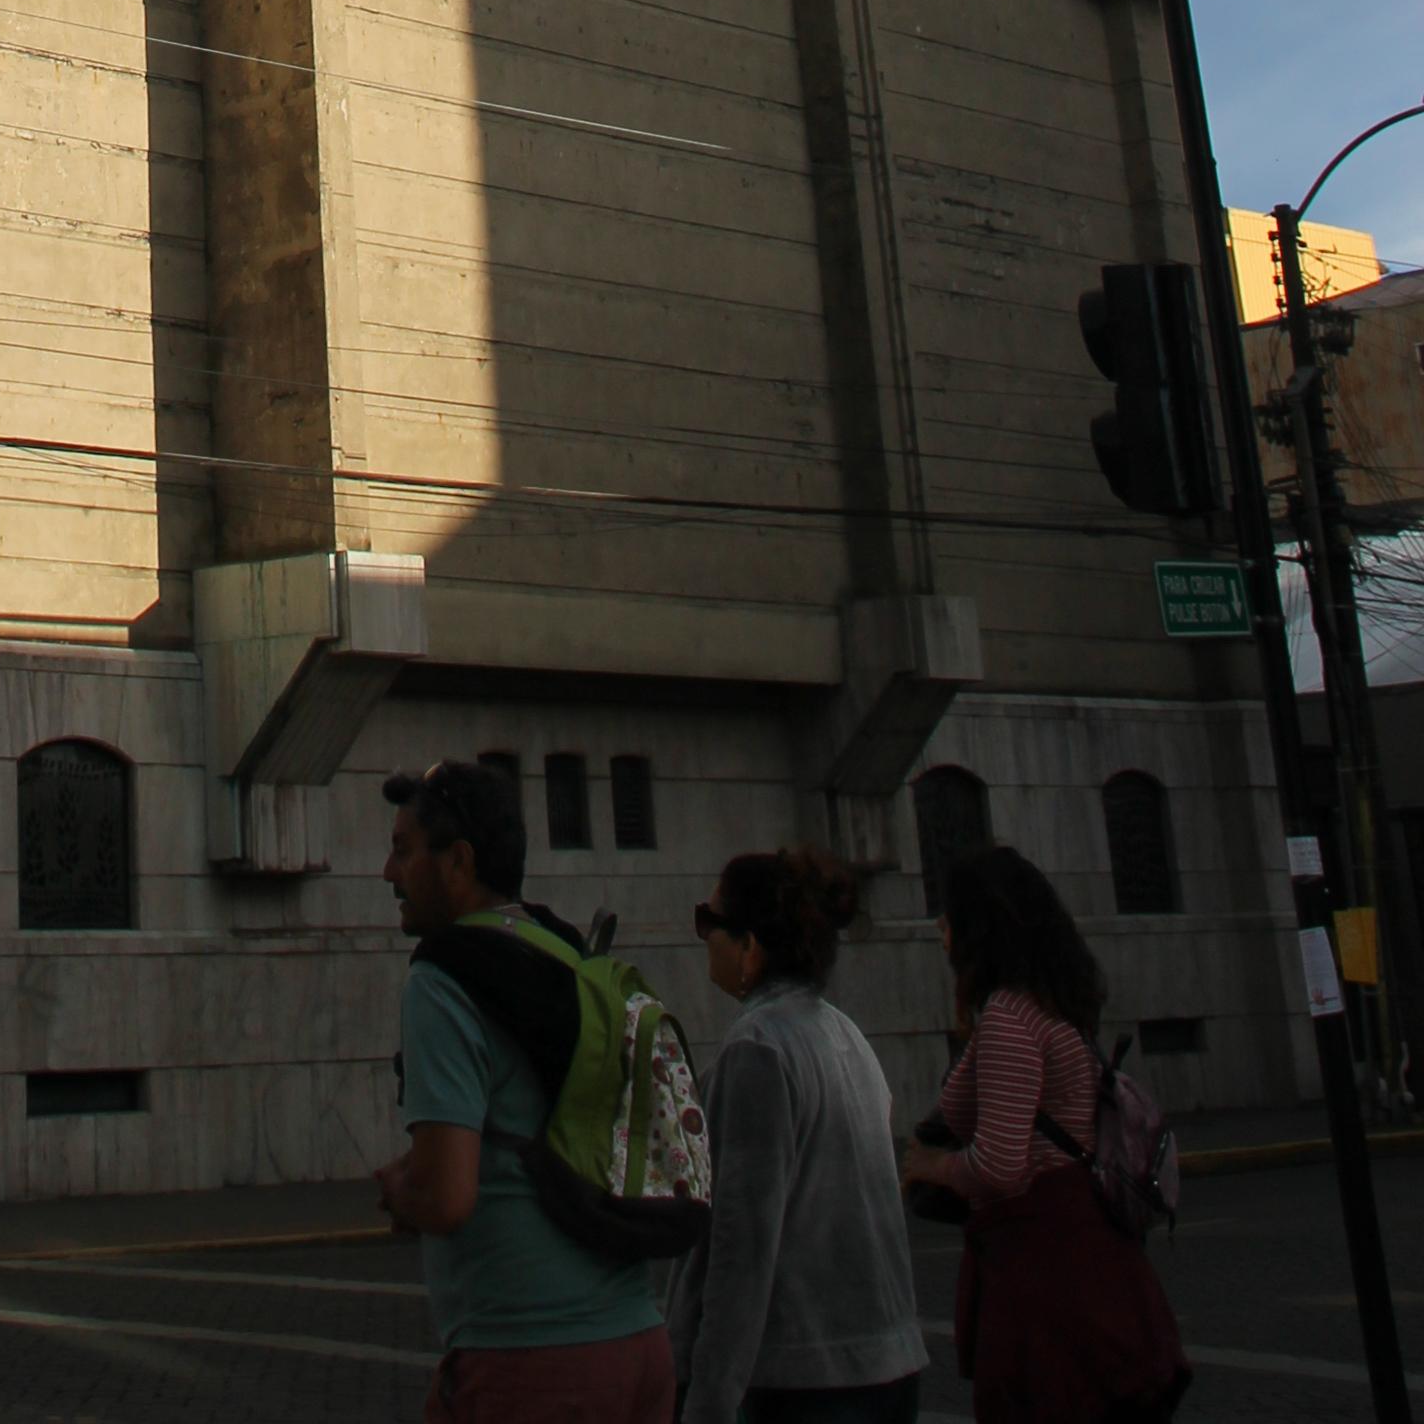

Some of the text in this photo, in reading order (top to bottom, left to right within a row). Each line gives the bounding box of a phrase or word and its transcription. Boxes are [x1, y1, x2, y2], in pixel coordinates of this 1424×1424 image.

[1163, 575, 1226, 594] PARA CRUZAR
[1168, 602, 1199, 622] PULSE
